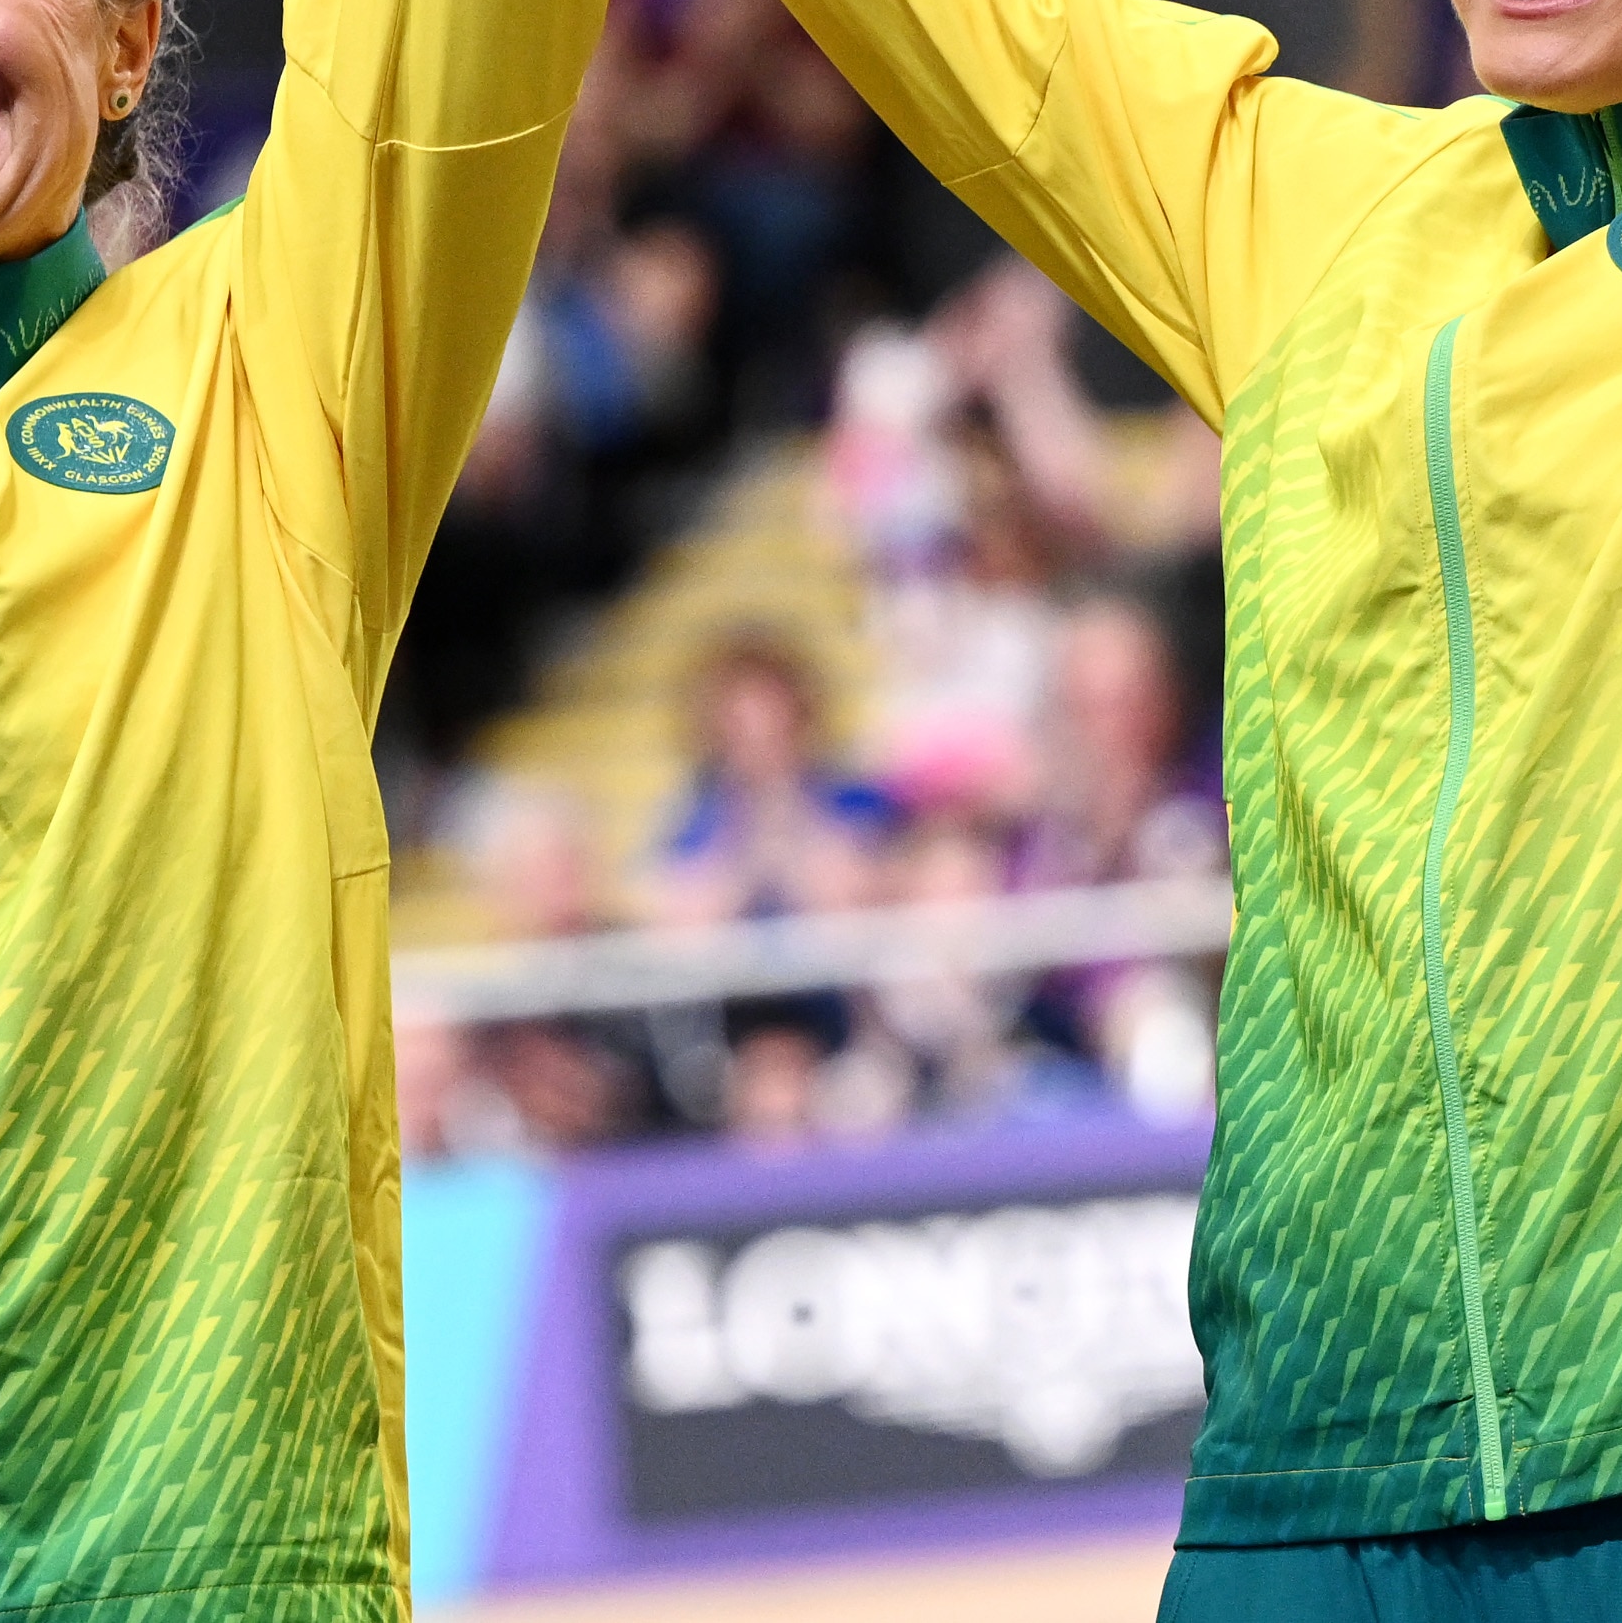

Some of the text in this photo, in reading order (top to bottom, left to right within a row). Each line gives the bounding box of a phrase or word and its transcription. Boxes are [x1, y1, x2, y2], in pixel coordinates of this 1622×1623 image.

[21, 398, 122, 445] COMMONWEALTH
[126, 403, 167, 440] GAMES
[70, 417, 106, 449] AUS
[64, 445, 168, 485] GLASGOW 2026
